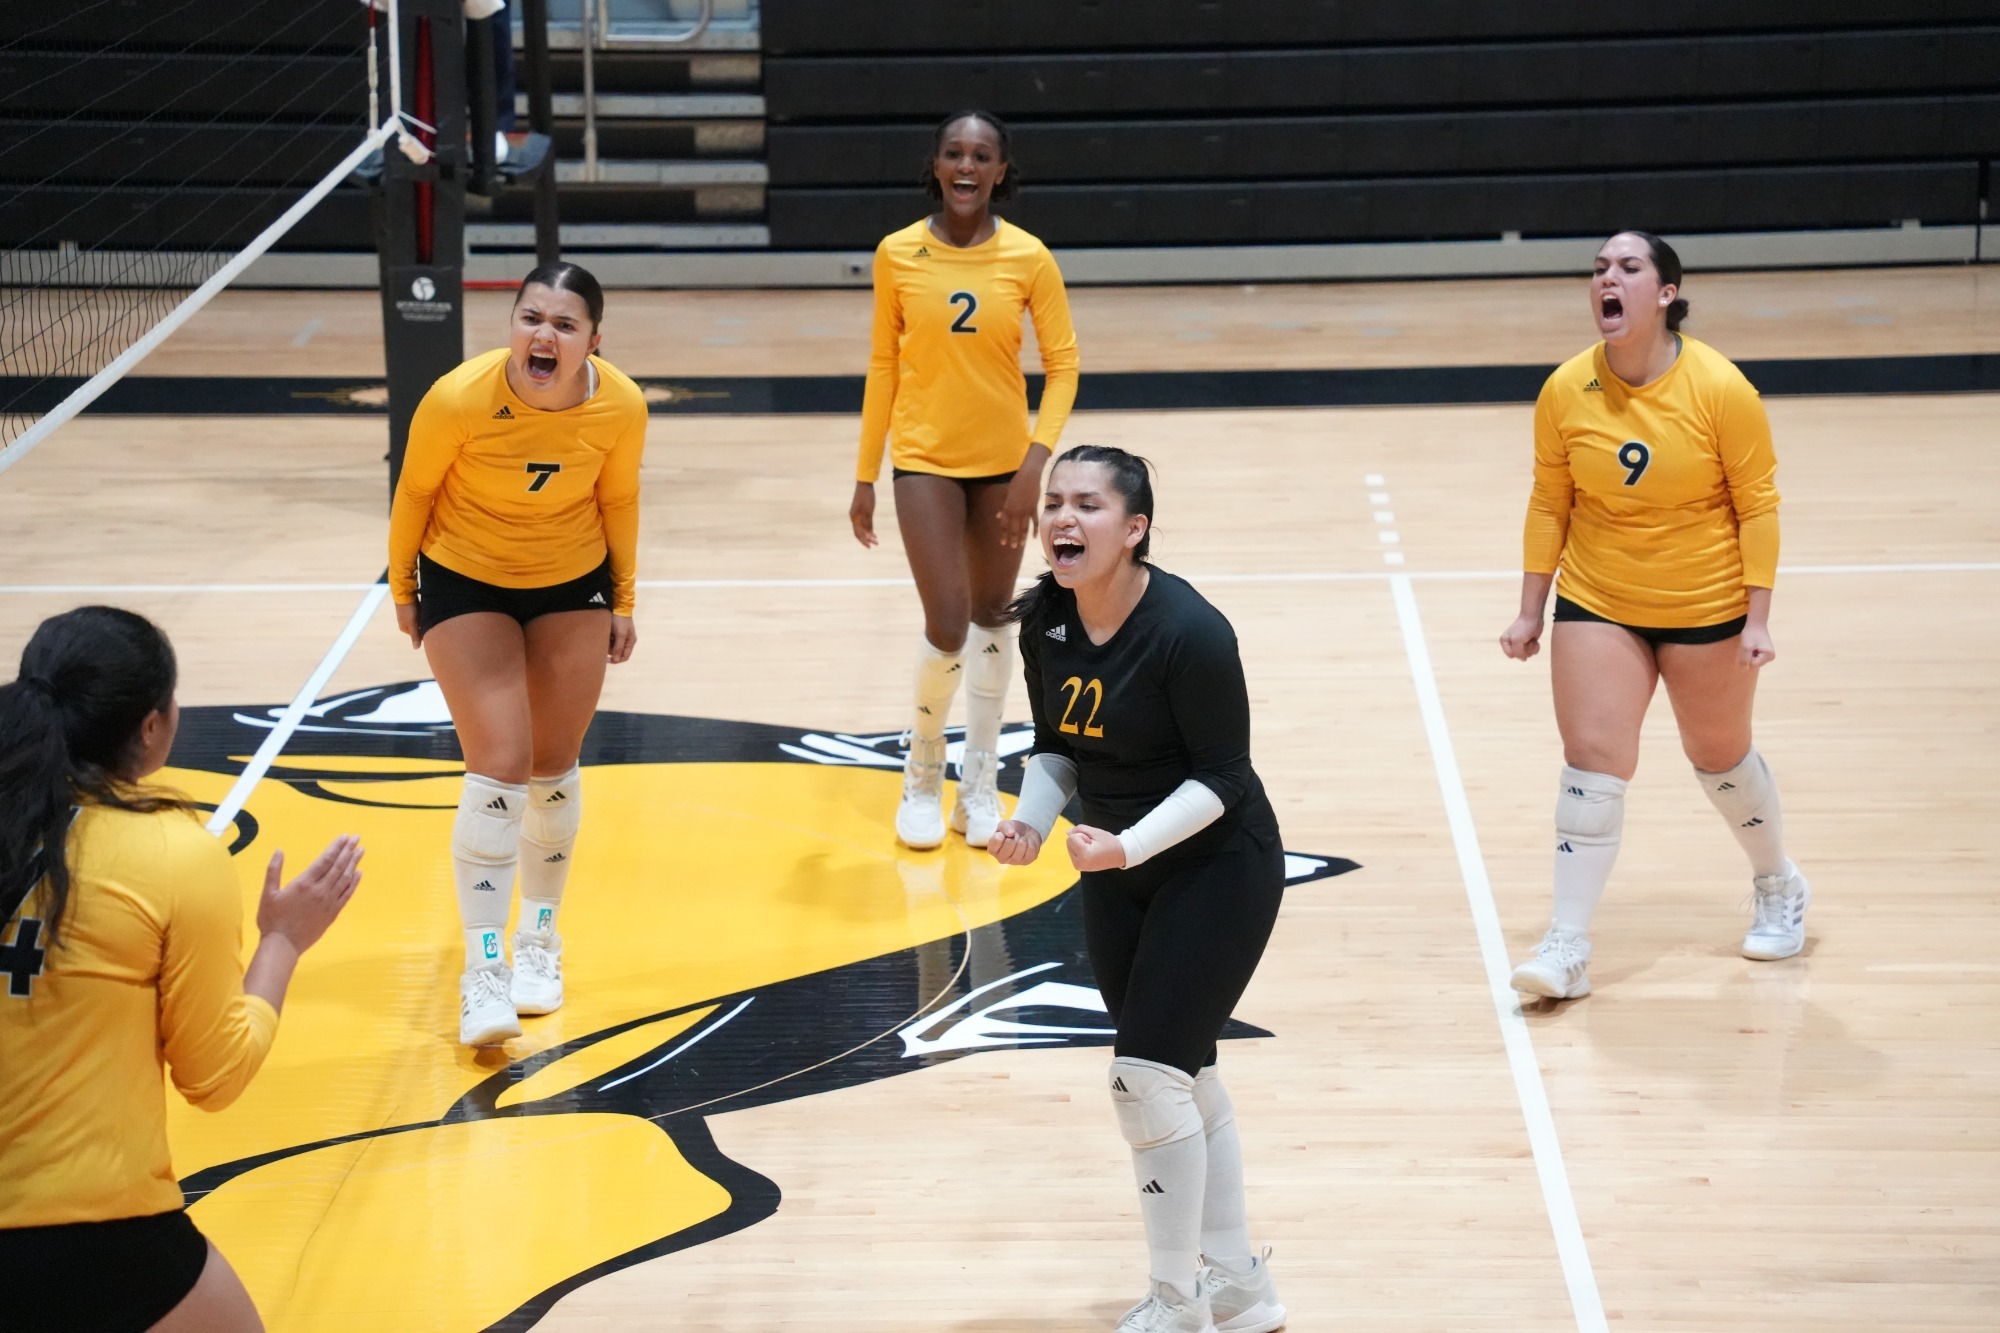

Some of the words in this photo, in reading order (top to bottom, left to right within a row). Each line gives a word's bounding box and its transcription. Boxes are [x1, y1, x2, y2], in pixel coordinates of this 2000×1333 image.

[948, 291, 978, 335] 2
[526, 462, 562, 493] 7
[1618, 441, 1650, 487] 9
[1045, 630, 1066, 641] adidas
[1059, 676, 1104, 738] 22
